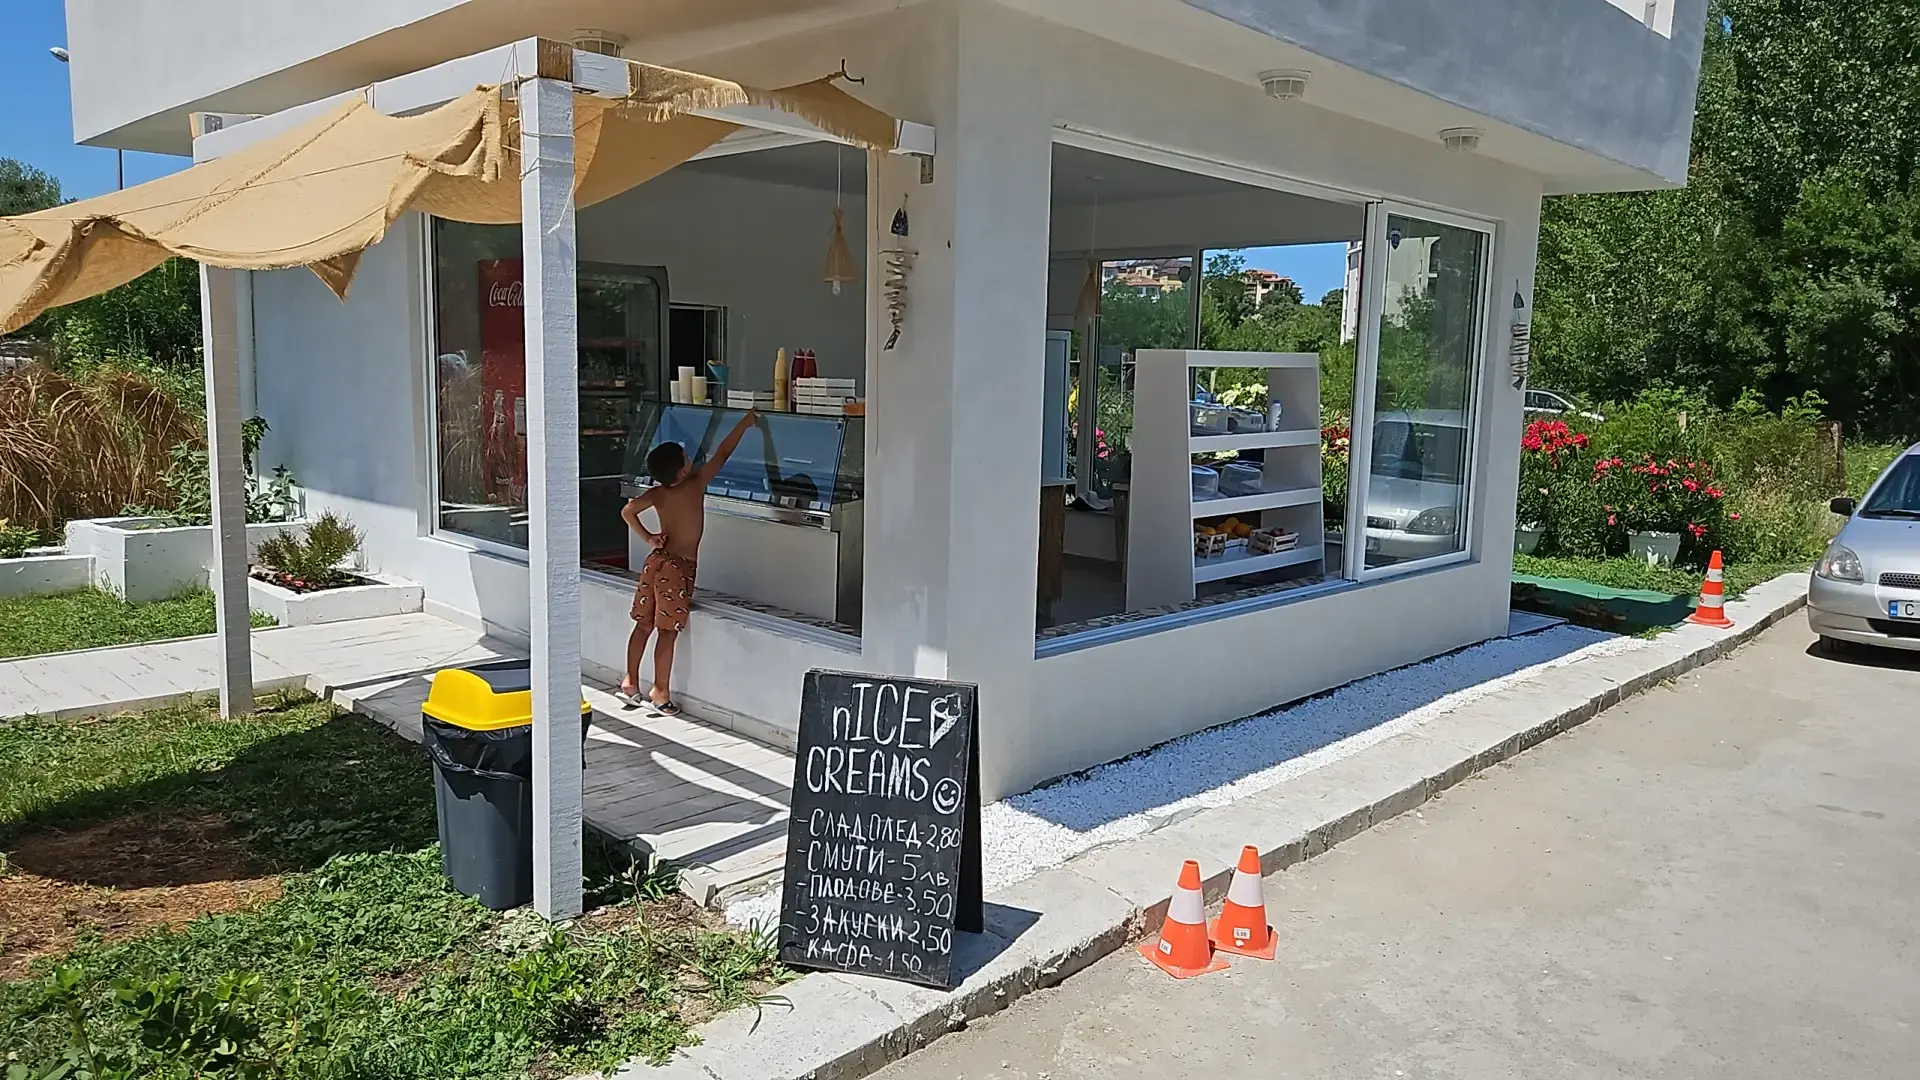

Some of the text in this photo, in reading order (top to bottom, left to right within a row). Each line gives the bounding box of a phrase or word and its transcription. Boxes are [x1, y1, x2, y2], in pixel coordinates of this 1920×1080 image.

[1905, 603, 1914, 616] C
[832, 683, 930, 749] nICE
[806, 745, 931, 802] CREAMS
[901, 853, 922, 881] 5
